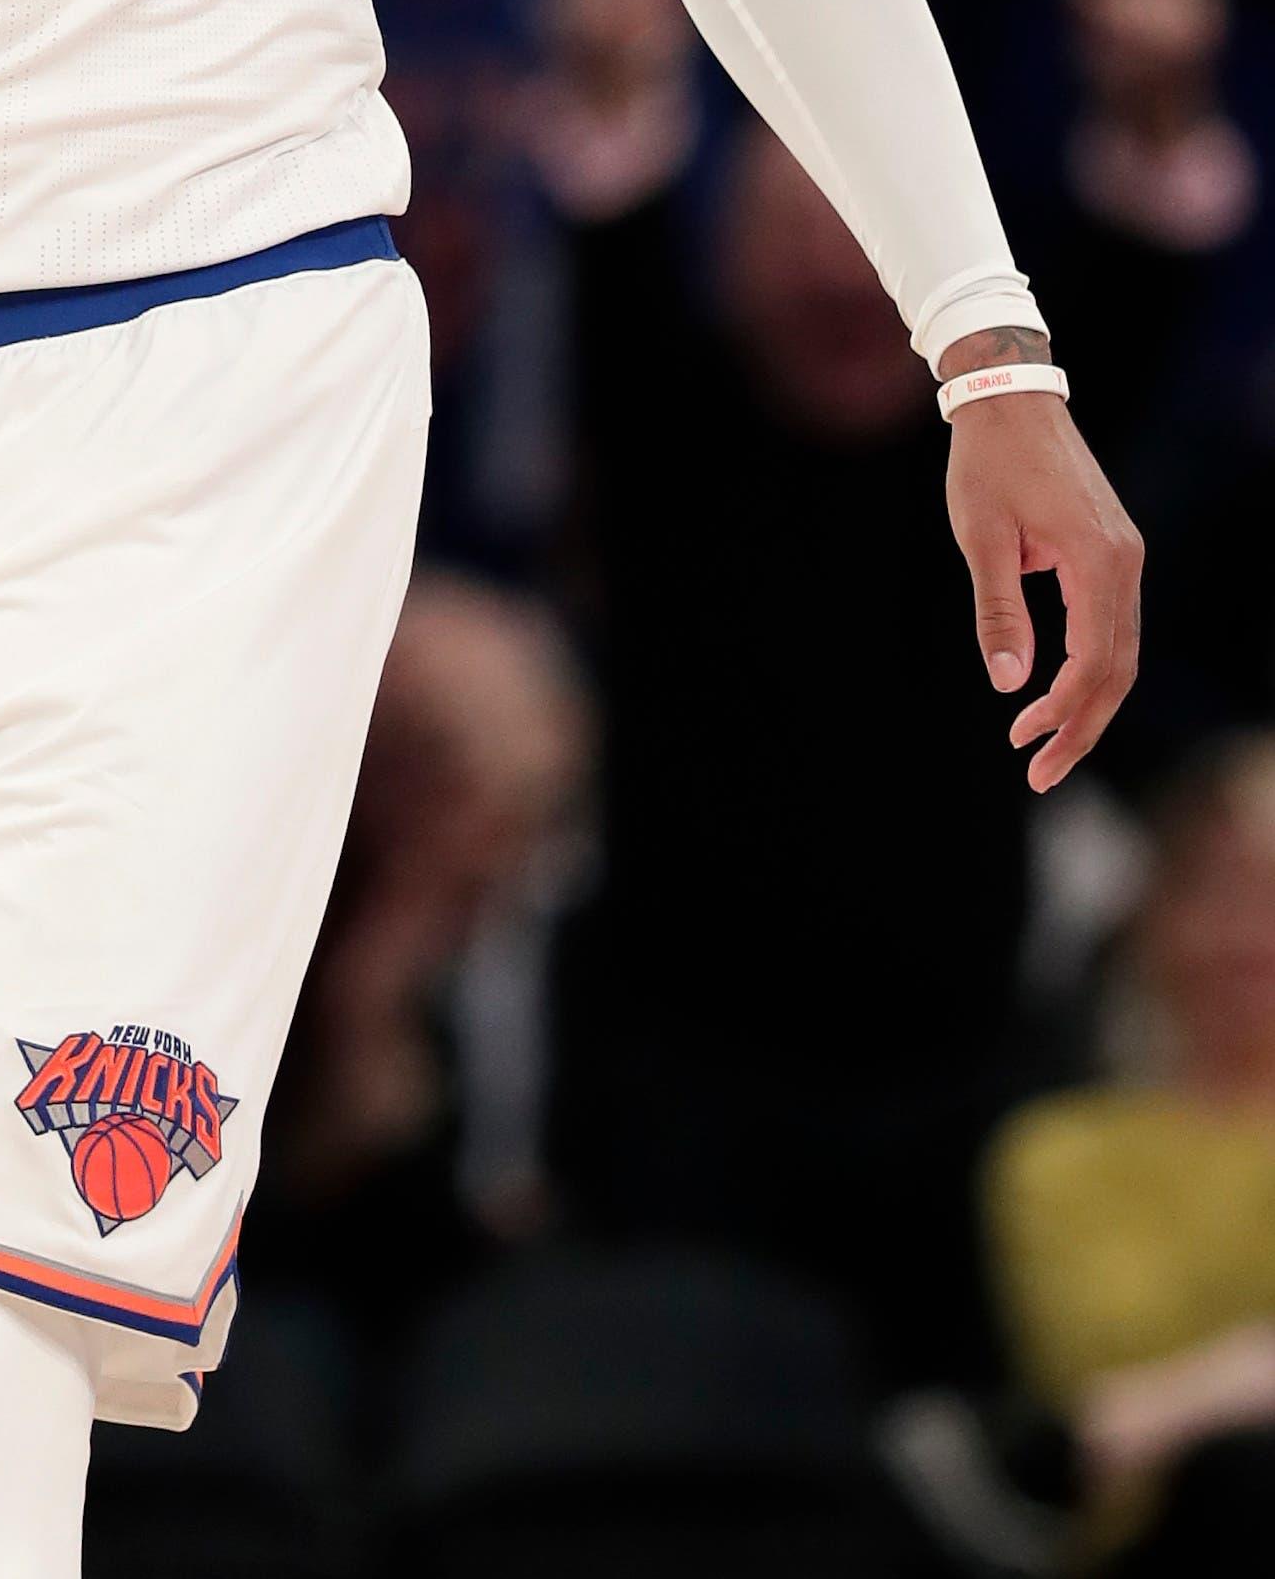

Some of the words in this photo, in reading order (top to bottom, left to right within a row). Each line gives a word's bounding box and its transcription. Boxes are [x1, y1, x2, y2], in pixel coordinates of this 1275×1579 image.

[107, 1024, 150, 1046] NEW
[153, 1029, 192, 1064] YORK
[14, 1030, 222, 1164] KNICKS
